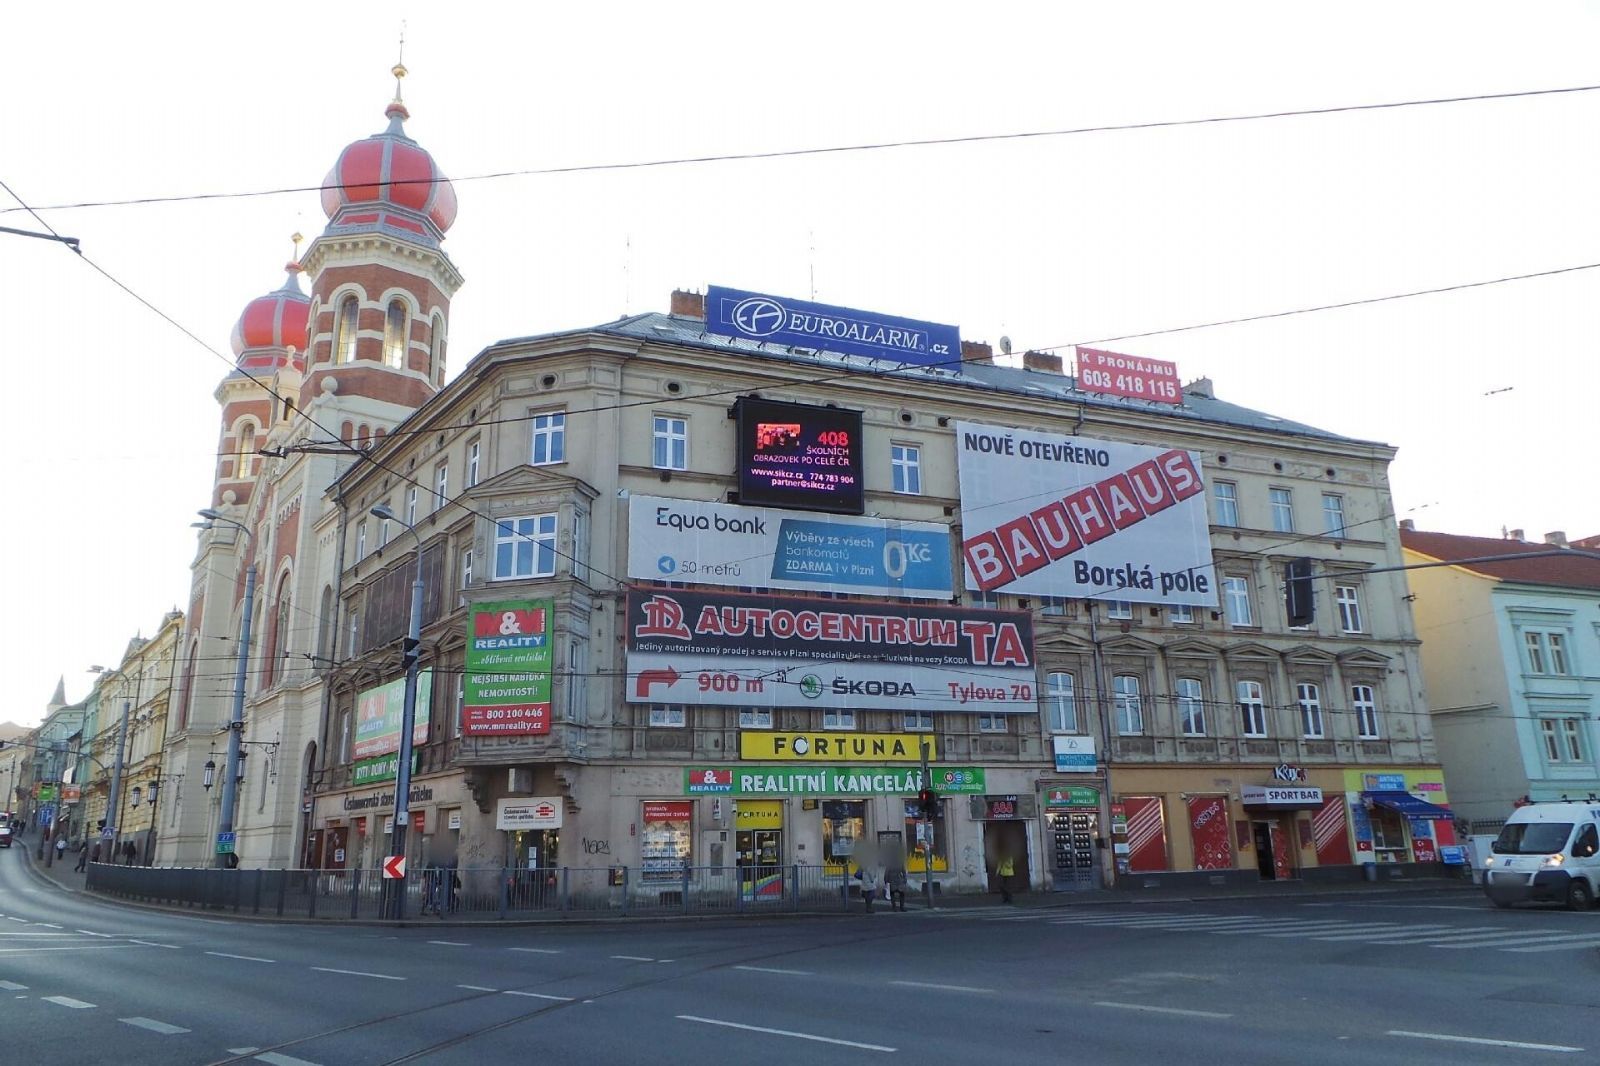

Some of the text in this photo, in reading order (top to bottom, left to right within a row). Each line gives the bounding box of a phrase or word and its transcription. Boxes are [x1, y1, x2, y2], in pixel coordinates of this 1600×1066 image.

[788, 313, 920, 350] EUROALARM
[1081, 353, 1173, 376] K PRONÁJMU
[1083, 369, 1176, 398] 603 418 115
[818, 431, 849, 446] 408
[806, 445, 849, 455] ŠKOLNÍCH
[964, 432, 1110, 467] NOVĚ OTEVŘENO
[753, 454, 850, 466] OBRAZOVEK PO CELÉ ČR
[810, 472, 824, 481] 774
[840, 476, 854, 484] 904
[657, 507, 766, 536] Equa bank
[968, 455, 1194, 583] BAUHAUS
[785, 530, 874, 548] Výběry ze všech
[786, 545, 850, 560] bankomatů
[883, 540, 931, 578] 0 Kč
[681, 560, 741, 577] 50 metrů
[786, 559, 833, 573] ZDARMA
[851, 564, 874, 576] Plzni
[1073, 560, 1208, 596] Borská pole
[475, 637, 542, 649] REALITY
[695, 605, 957, 647] AUTOCENTRUM
[961, 620, 1030, 667] TA
[664, 644, 720, 655] autorizovaný
[722, 647, 749, 656] prodej
[757, 648, 781, 656] servis
[943, 655, 969, 664] ŠKODA
[698, 673, 763, 692] 900 m
[832, 676, 917, 697] ŠKODA
[948, 682, 1032, 704] Tylova 70
[487, 711, 503, 719] 800
[507, 709, 522, 718] 100
[774, 736, 906, 756] FORTUNA
[741, 771, 923, 792] REALITNÍ KANCELÁŘ
[1269, 791, 1319, 800] SPORT BAR
